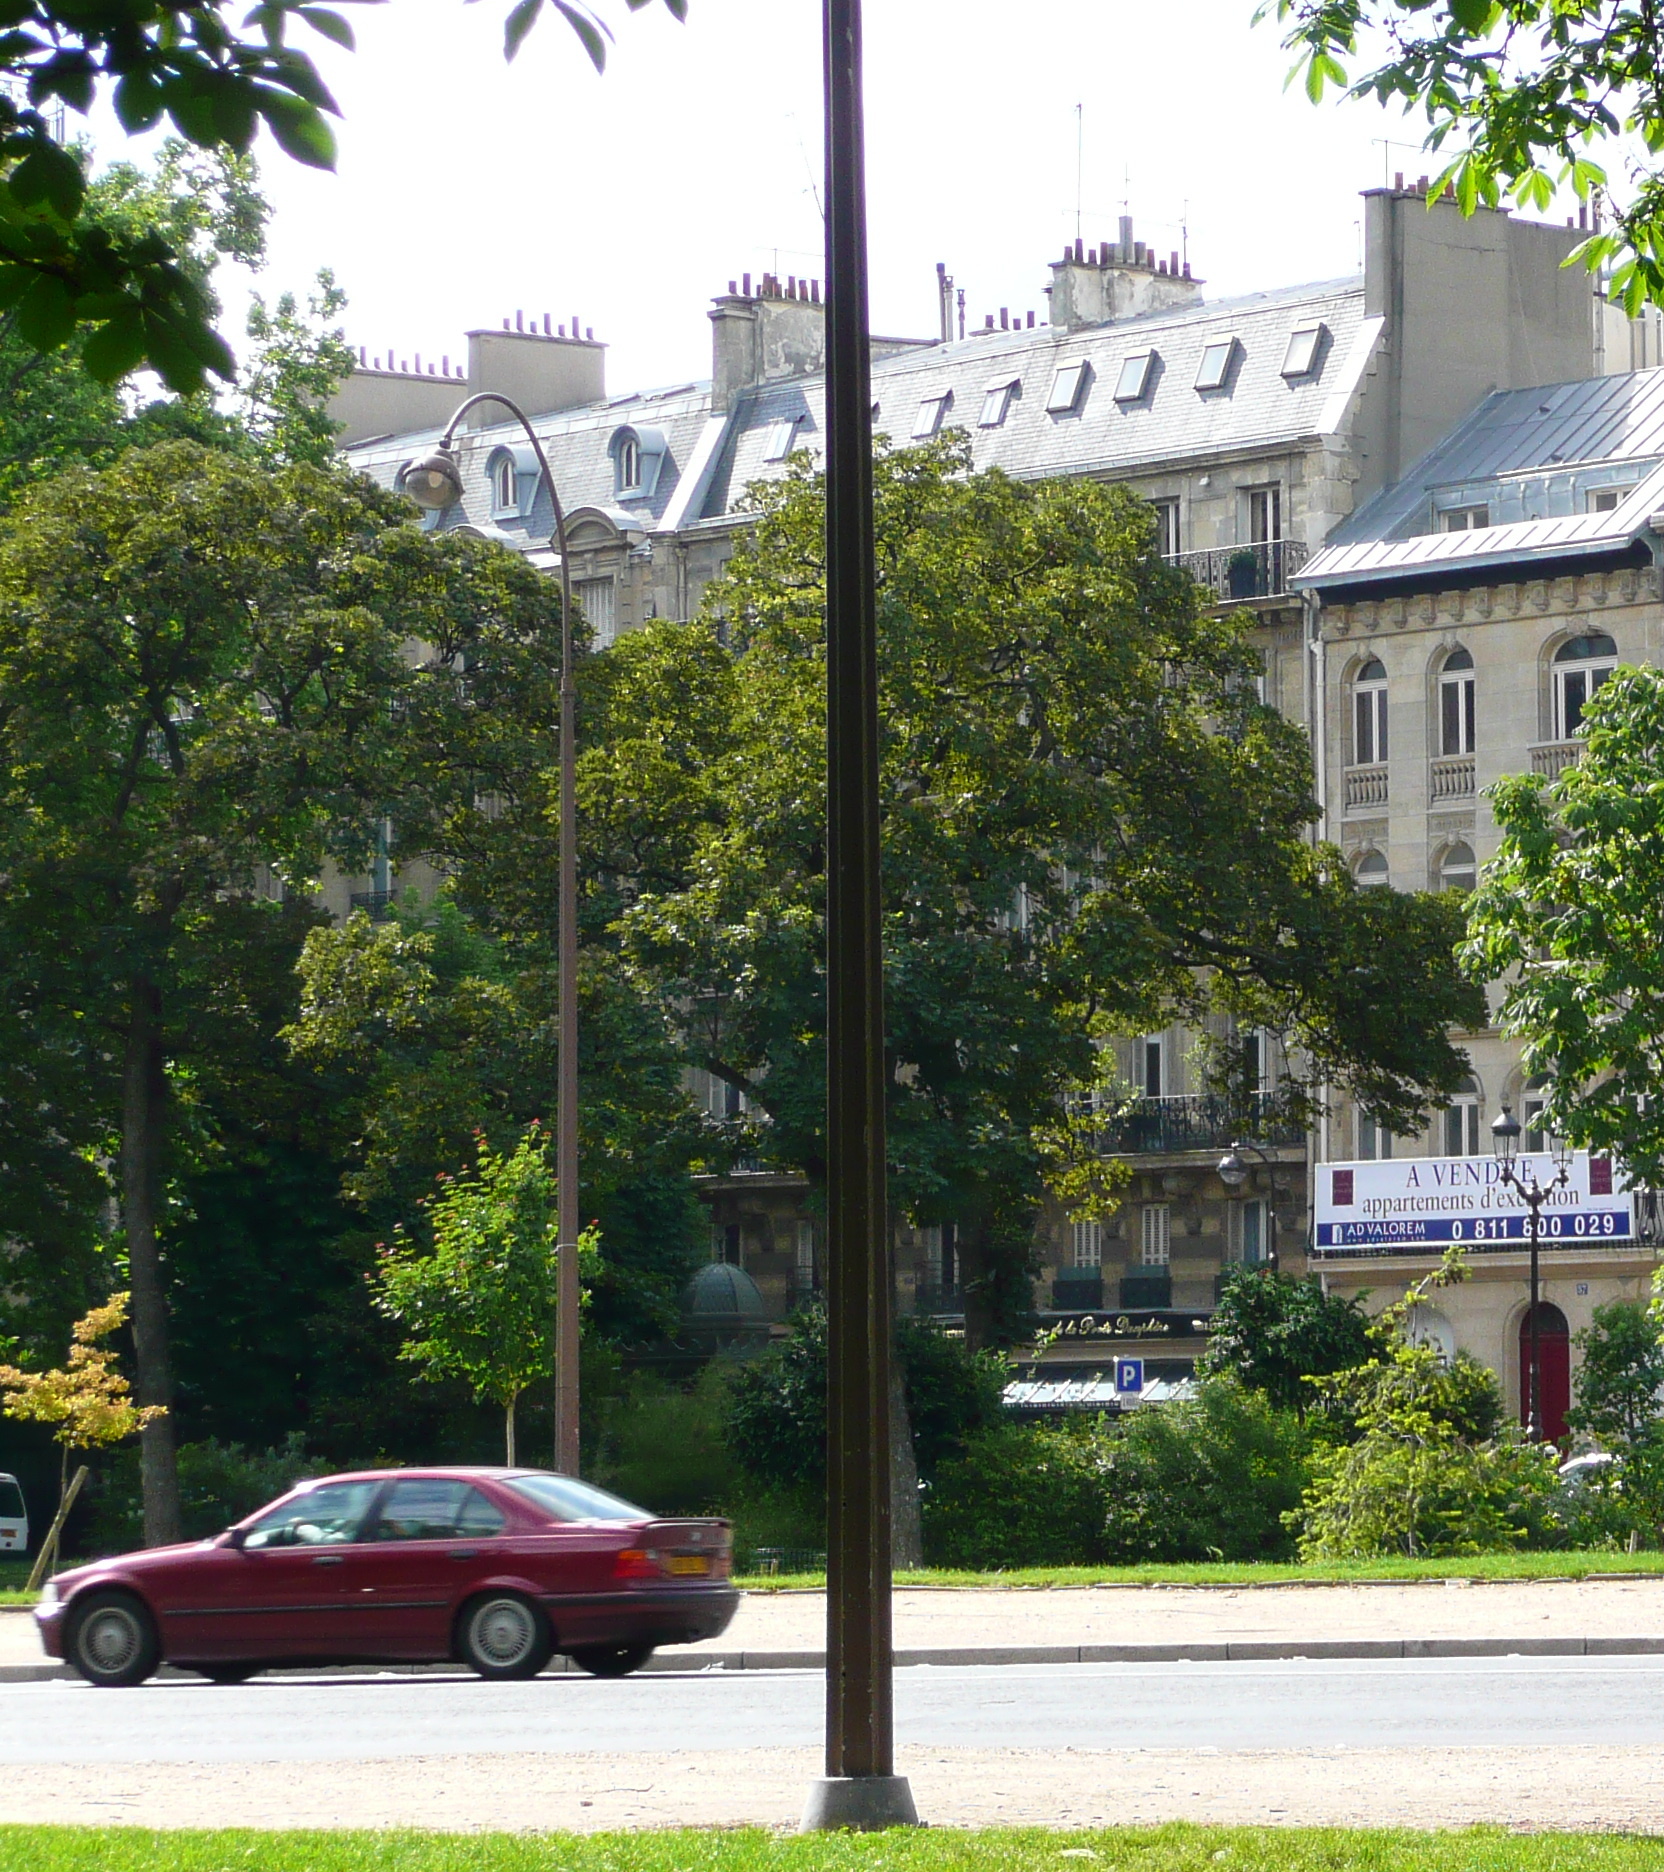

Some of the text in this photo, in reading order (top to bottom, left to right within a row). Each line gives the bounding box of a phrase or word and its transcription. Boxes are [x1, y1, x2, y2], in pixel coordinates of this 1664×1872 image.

[1406, 1165, 1420, 1188] A
[1363, 1185, 1579, 1219] appartements d'exction
[1347, 1222, 1425, 1236] AD VALOREM
[1452, 1214, 1614, 1240] 0 811 800 029
[1123, 1365, 1136, 1387] P
